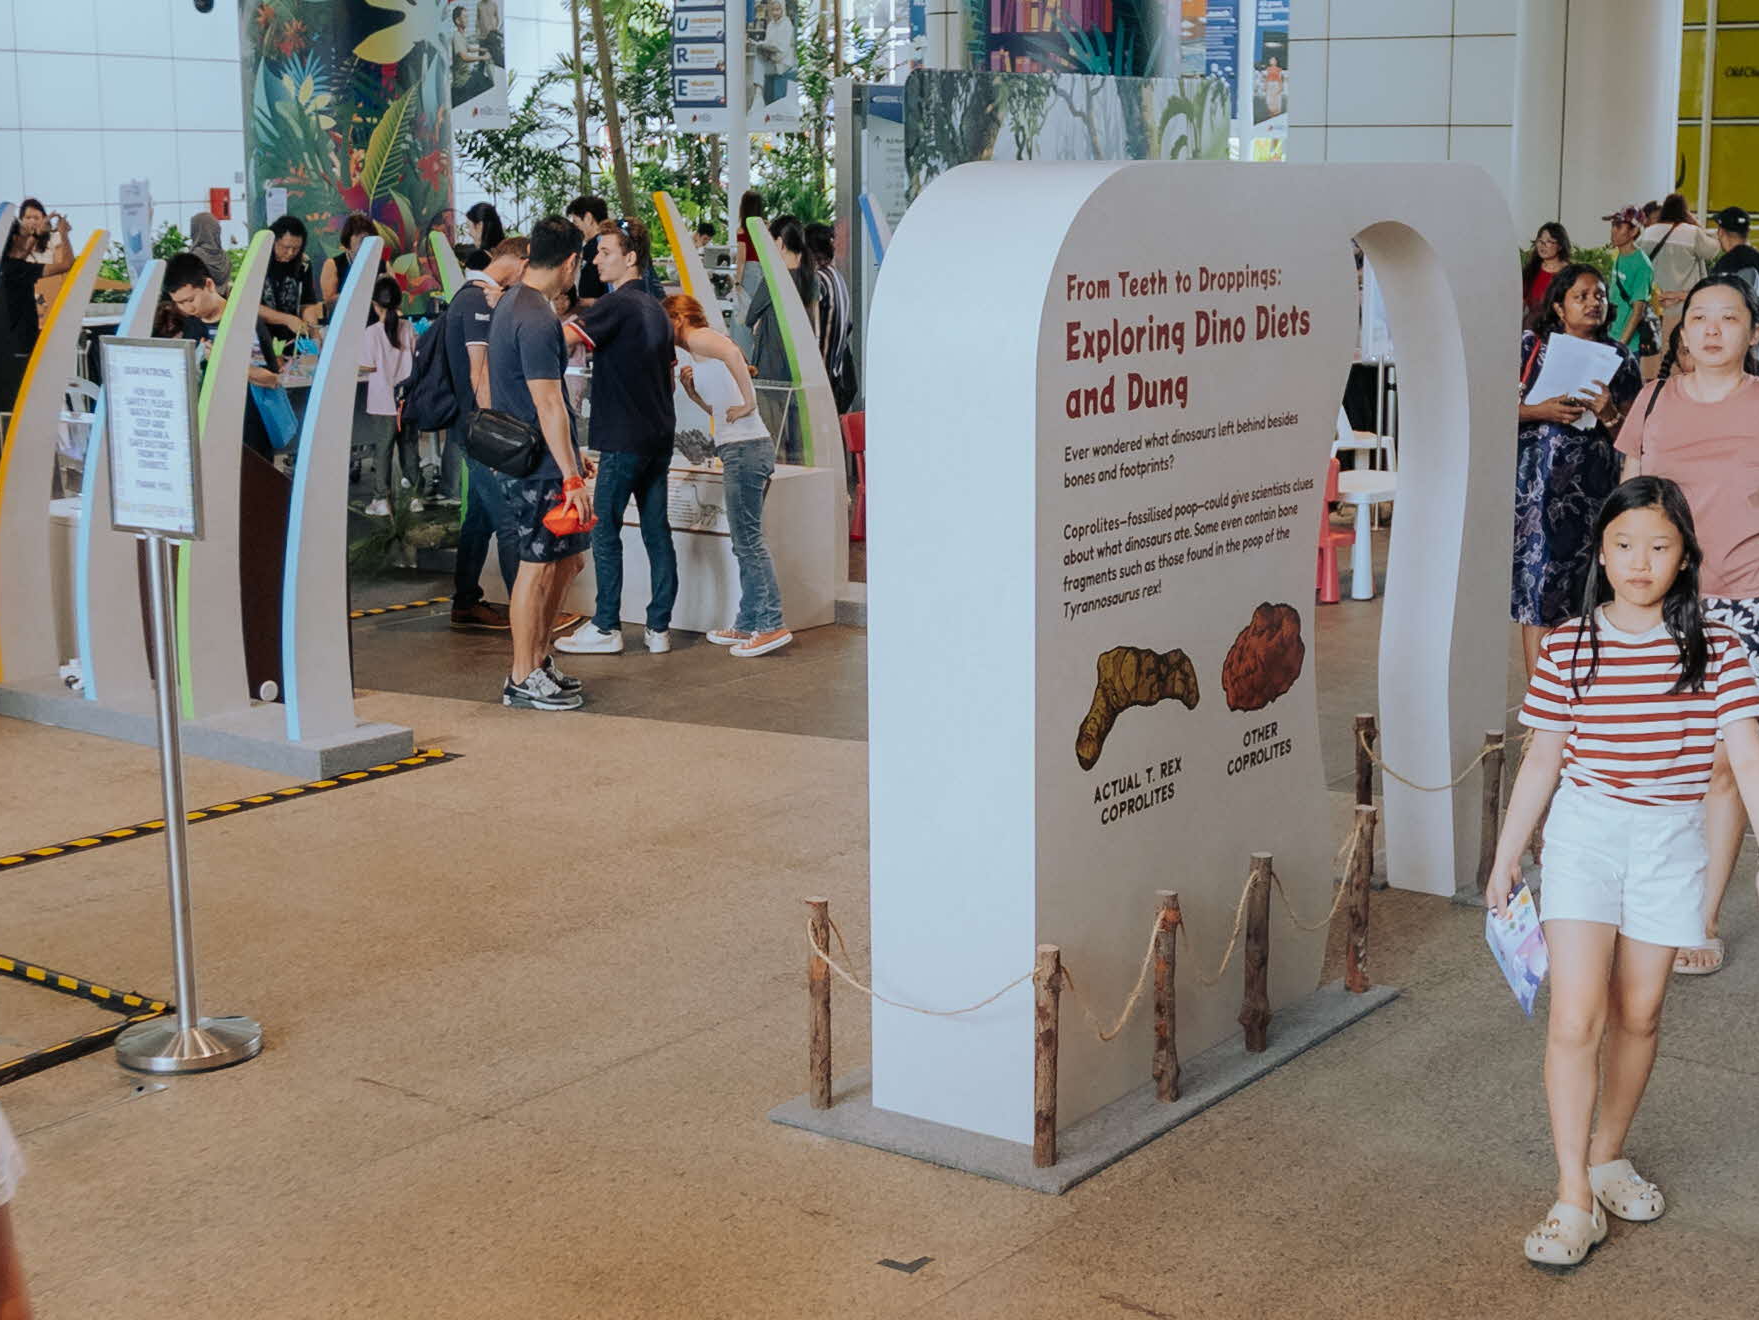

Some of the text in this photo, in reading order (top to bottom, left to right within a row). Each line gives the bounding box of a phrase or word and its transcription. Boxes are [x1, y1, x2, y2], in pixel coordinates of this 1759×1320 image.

[677, 17, 688, 31] U
[677, 48, 688, 63] R
[678, 80, 688, 96] E
[1067, 264, 1282, 301] From Teeth to Droppings:
[1066, 304, 1310, 363] Exploring Dino Diets
[1066, 373, 1188, 419] and Dung
[1065, 411, 1298, 462] Ever wondered what dinosaurs left behind besides
[1064, 455, 1174, 488] bones and footprints?
[1231, 490, 1249, 509] give
[1251, 483, 1291, 501] scientists
[1293, 478, 1314, 492] clues
[1064, 504, 1298, 566] about what dinosaurs ate. Some even contain bone
[1063, 526, 1290, 592] fragments such as those found in the poop of the
[1063, 580, 1162, 620] Tyrannosaurus rex!
[1243, 722, 1278, 747] OTHER
[1227, 739, 1292, 776] COPROLITES
[1094, 757, 1182, 804] ACTUAL T. REX
[1101, 783, 1175, 825] COPROLITES
